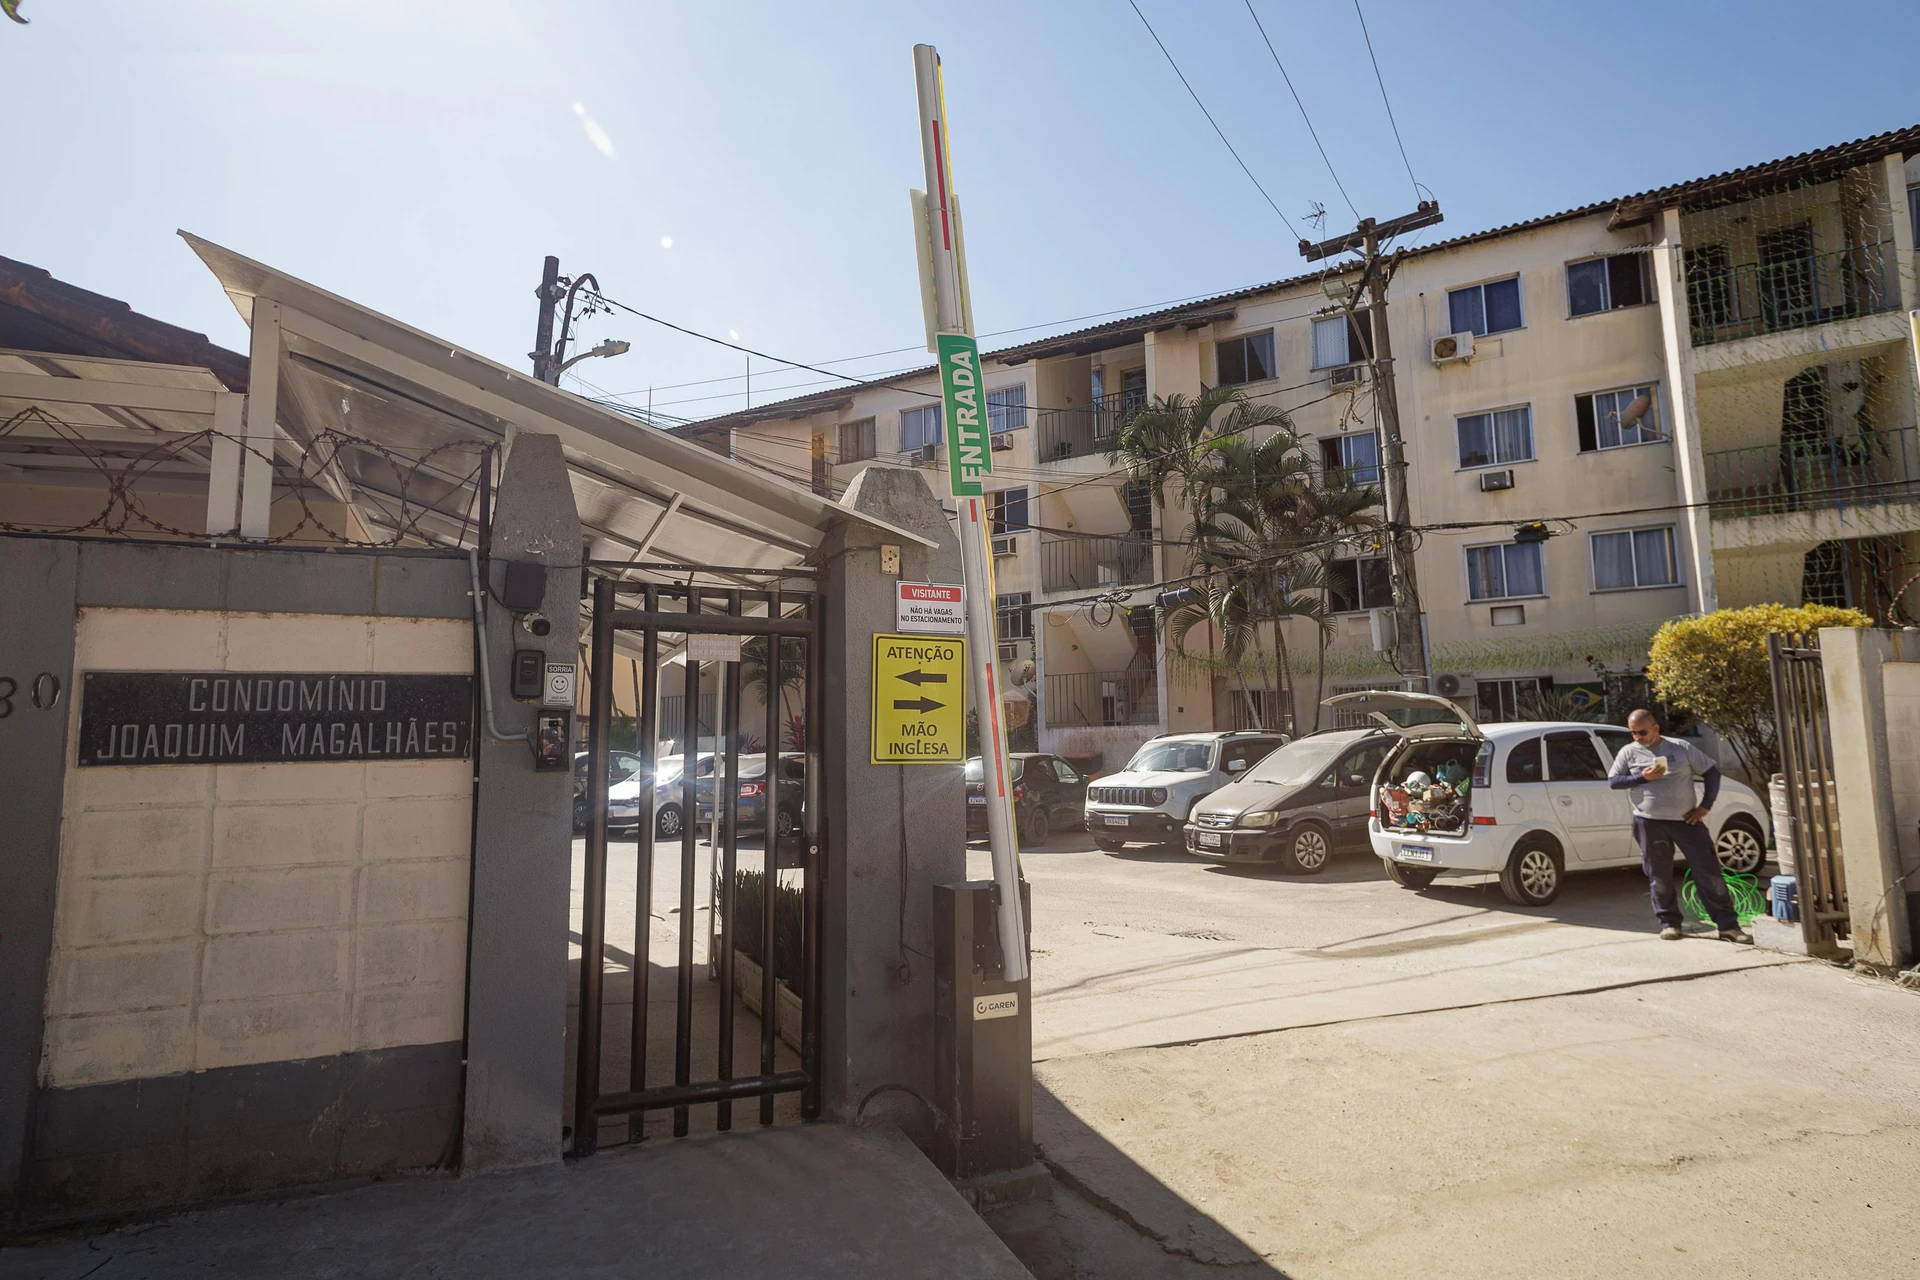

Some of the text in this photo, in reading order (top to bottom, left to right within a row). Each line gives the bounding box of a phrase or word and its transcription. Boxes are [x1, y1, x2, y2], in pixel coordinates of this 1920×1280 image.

[950, 350, 983, 482] ENTRADA
[911, 588, 951, 599] VISITANTE
[910, 605, 953, 616] NÃO HÁ VAGAS
[910, 615, 963, 624] ESTACIONAMENTO
[887, 645, 954, 663] ATENÇÃO
[548, 665, 573, 673] SORRIA
[901, 721, 938, 737] MÃO
[97, 724, 245, 758] JOAQUIM
[889, 741, 950, 755] INGLESA
[988, 1000, 1016, 1010] GAREN
